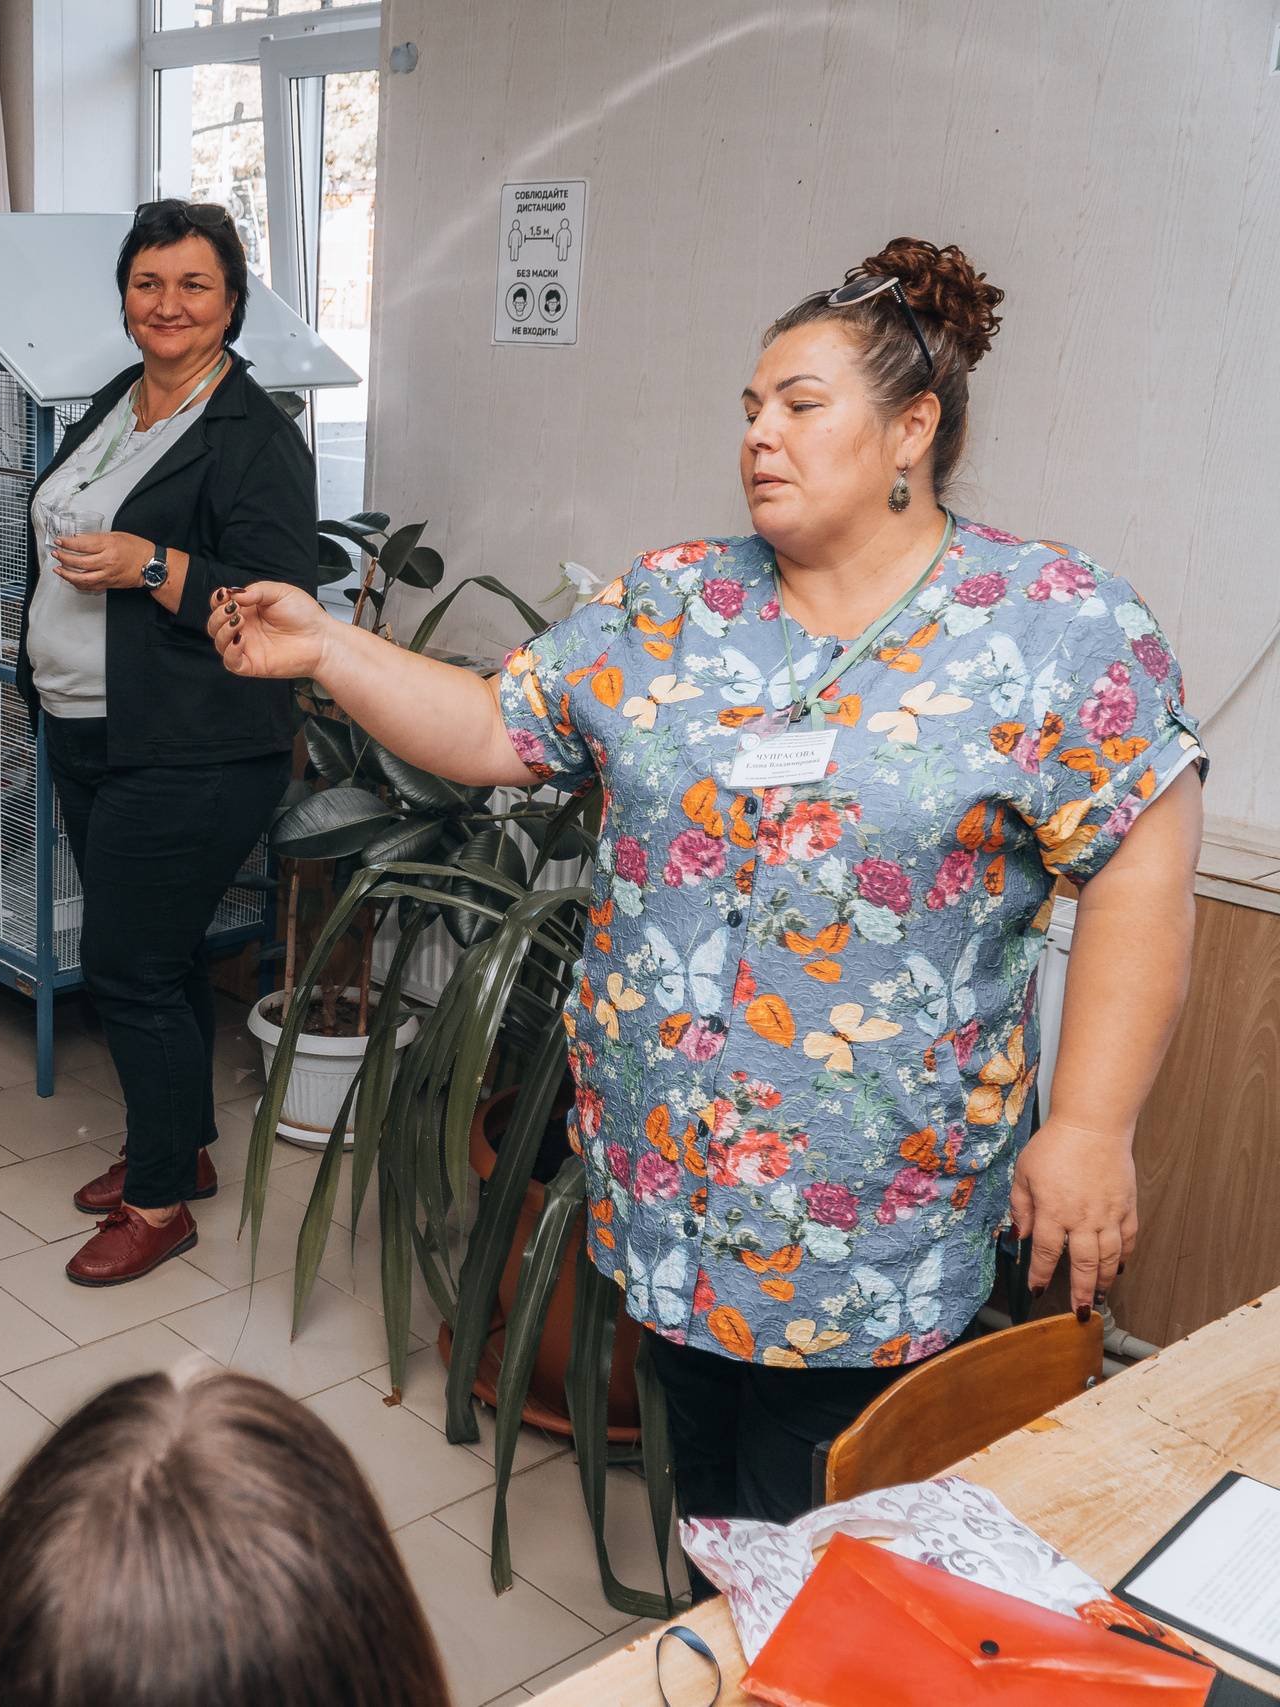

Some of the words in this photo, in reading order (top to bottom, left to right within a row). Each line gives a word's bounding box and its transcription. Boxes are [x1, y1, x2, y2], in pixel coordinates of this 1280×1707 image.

[515, 188, 568, 200] СОБЛЮДАЙТЕ
[517, 203, 566, 213] ДИСТАНЦИЮ
[530, 226, 541, 236] 1,5
[517, 269, 530, 277] БЕЗ
[532, 269, 558, 277] МАСКИ
[523, 327, 558, 336] ВХОДИТЬ!
[757, 750, 815, 760] ЧУПРАСОВА
[770, 758, 820, 768] Владимировна
